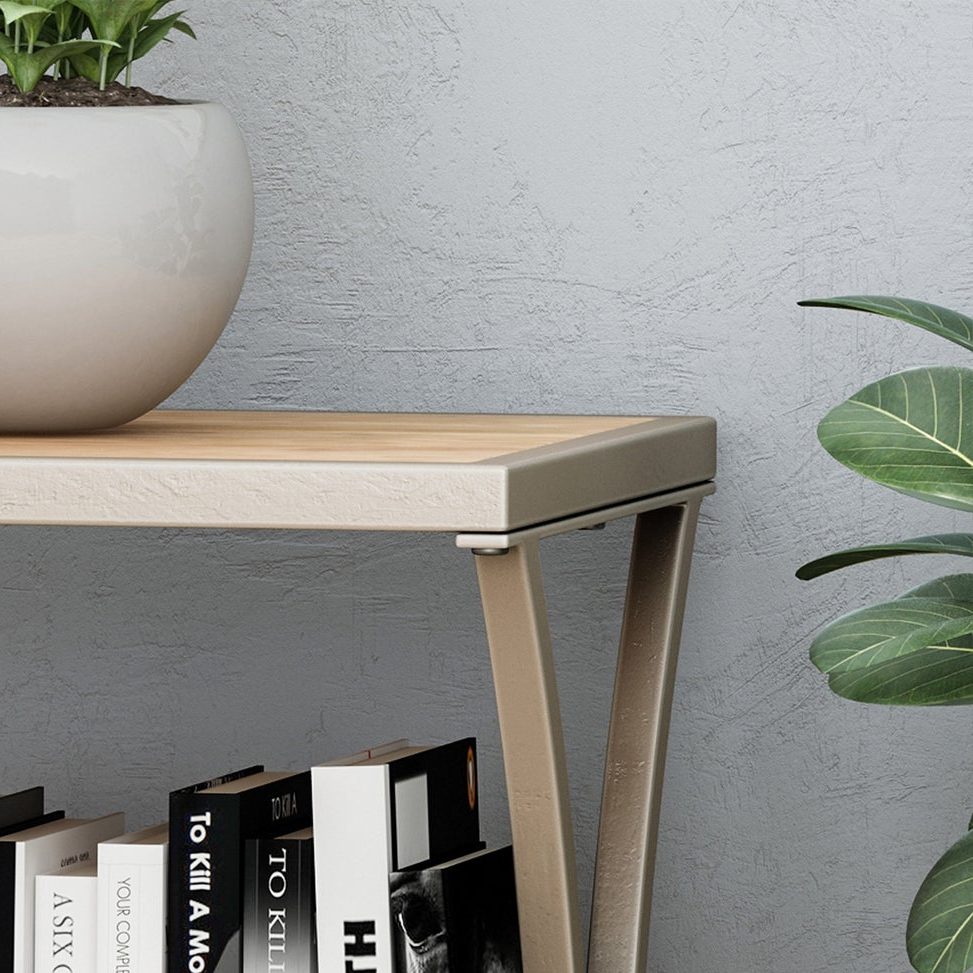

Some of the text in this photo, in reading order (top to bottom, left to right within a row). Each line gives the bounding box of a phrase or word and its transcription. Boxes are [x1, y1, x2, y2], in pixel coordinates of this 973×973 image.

[189, 811, 211, 844] To
[189, 852, 211, 891] Kill
[268, 848, 286, 898] TO
[53, 892, 73, 909] A
[116, 876, 131, 916] YOUR
[189, 900, 210, 922] A
[52, 915, 74, 957] SIX
